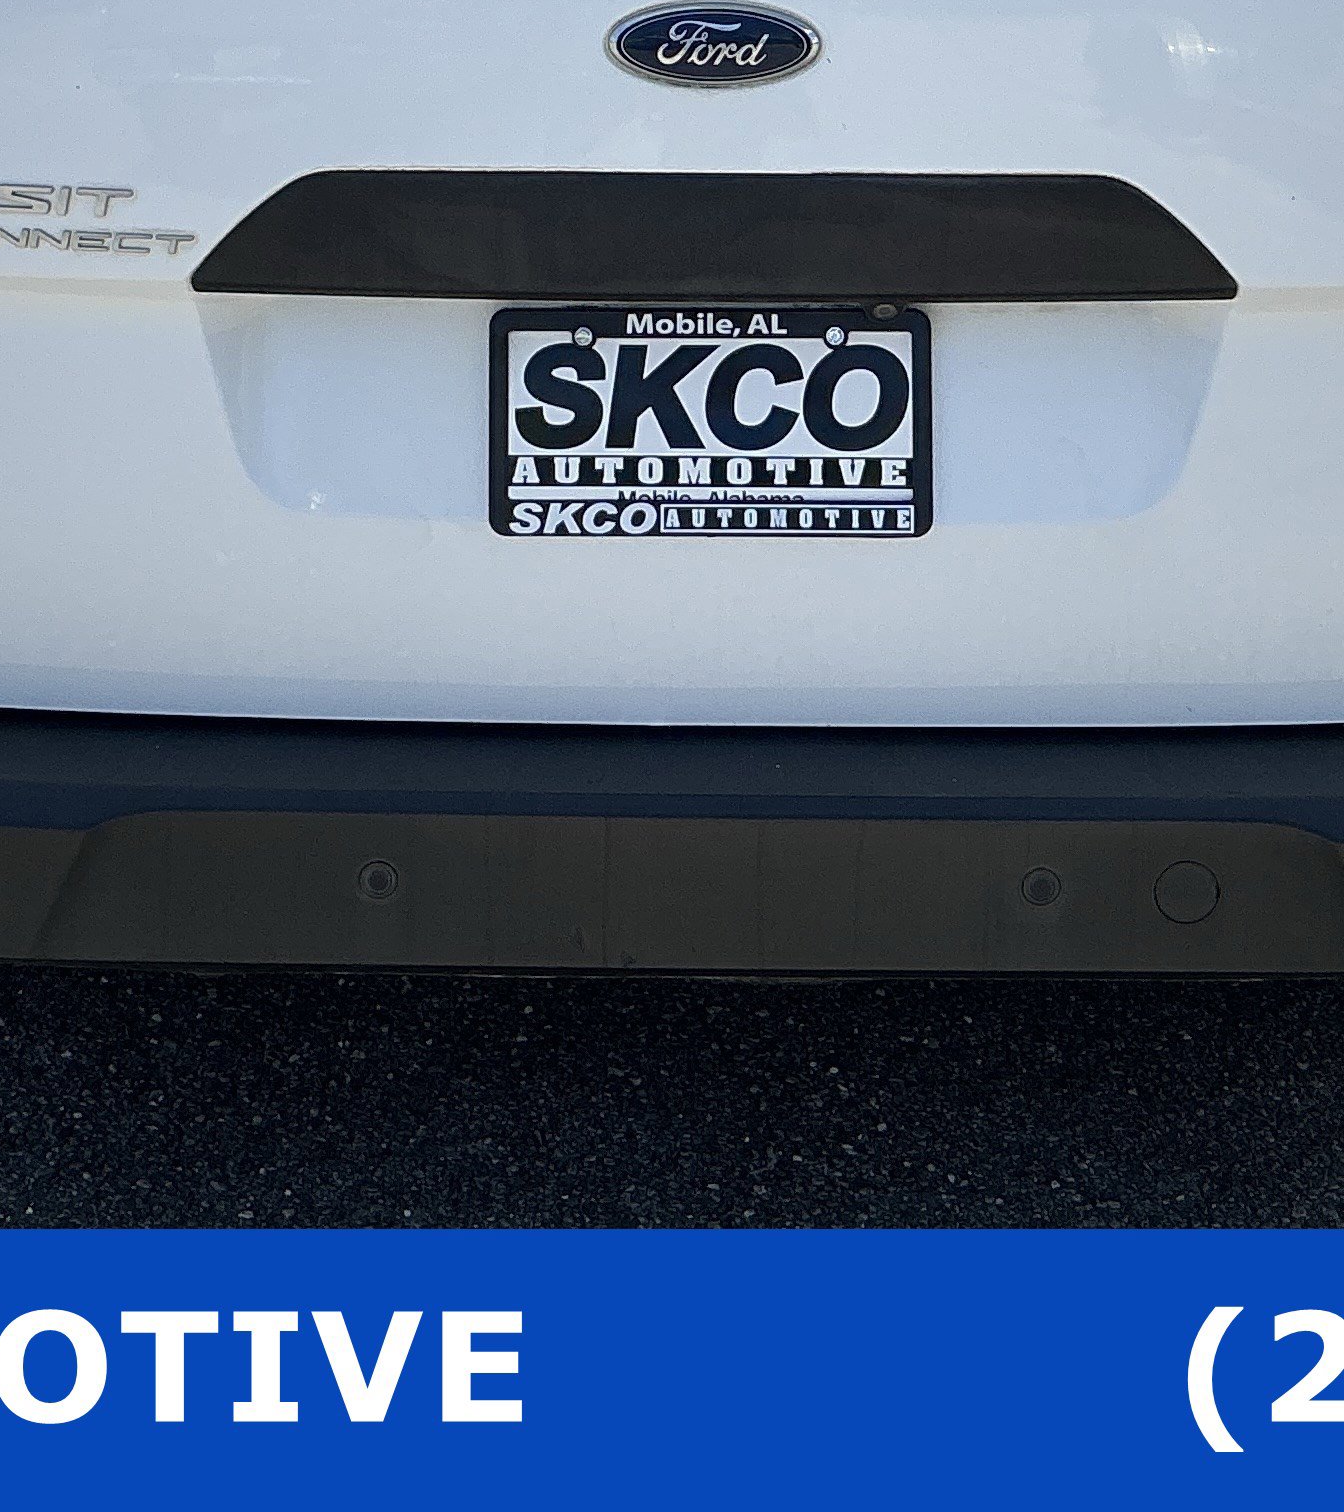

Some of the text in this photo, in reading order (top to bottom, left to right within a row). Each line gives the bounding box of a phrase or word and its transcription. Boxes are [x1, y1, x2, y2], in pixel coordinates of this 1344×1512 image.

[657, 20, 771, 66] Ford
[626, 313, 788, 338] Mobile, AL
[514, 343, 910, 451] SKCO
[512, 457, 907, 486] AUTOMOTIVE
[509, 502, 912, 535] SKCO AUTOMOTIVE
